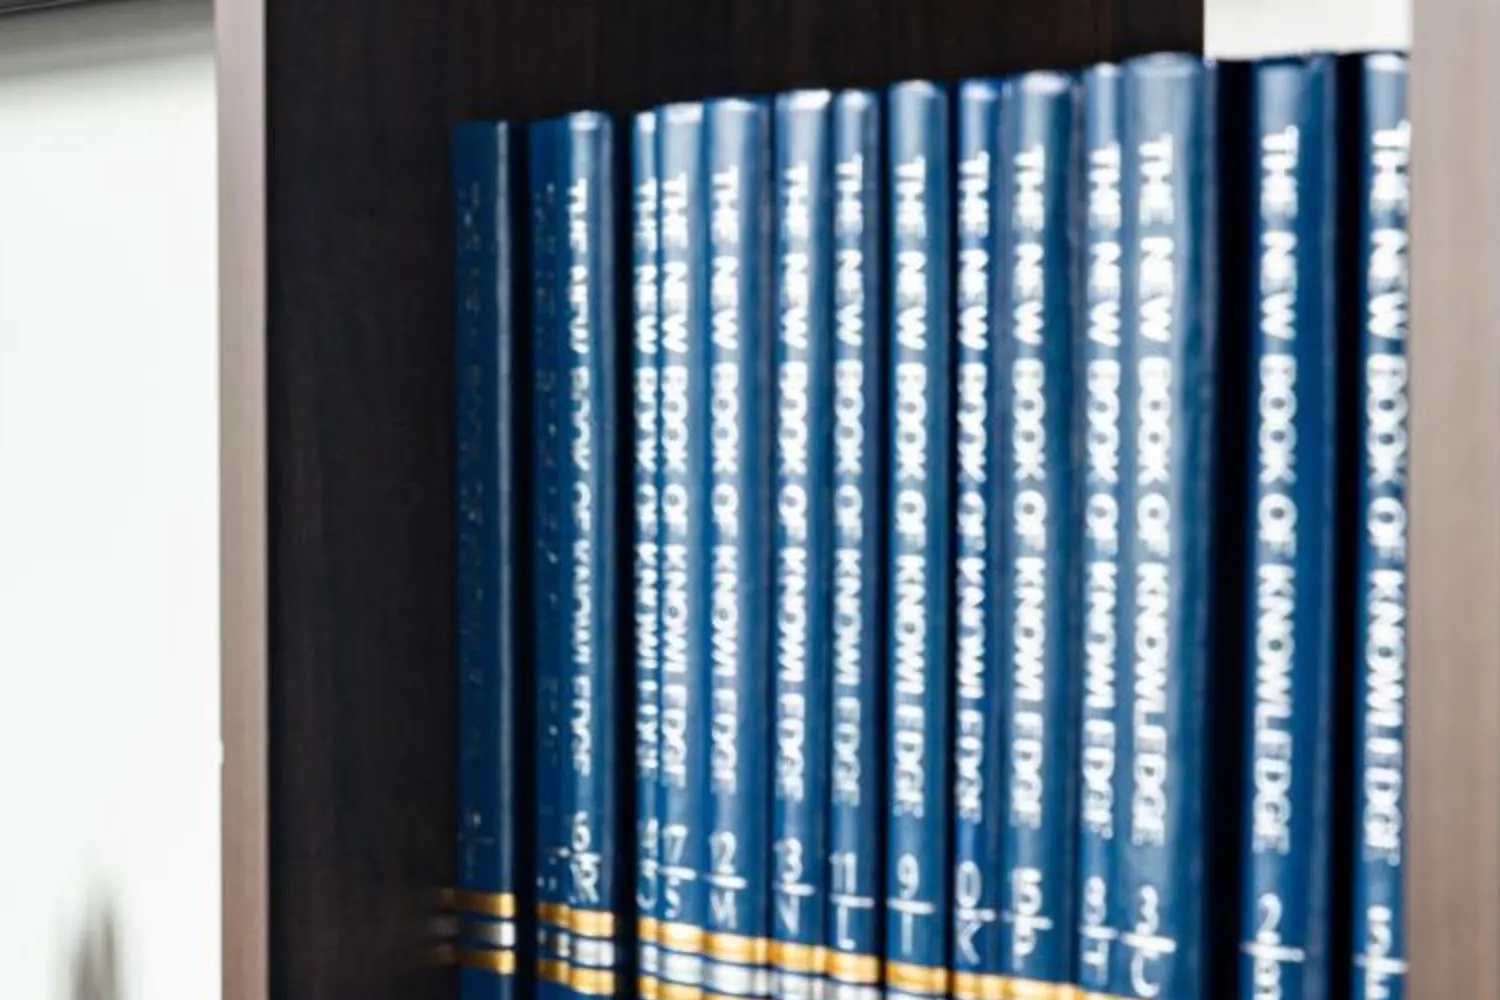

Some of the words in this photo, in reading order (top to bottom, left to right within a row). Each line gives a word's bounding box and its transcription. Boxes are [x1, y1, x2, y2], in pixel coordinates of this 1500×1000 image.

[662, 173, 690, 247] THE
[711, 167, 739, 243] THE
[782, 162, 809, 237] THE
[835, 155, 864, 232] THE
[896, 157, 927, 232] THE
[958, 152, 990, 232] THE
[1013, 145, 1045, 227] THE
[1088, 143, 1122, 226] THE
[1138, 137, 1174, 215] THE
[1261, 127, 1300, 212] THE
[1370, 124, 1409, 212] THE
[661, 260, 690, 354] NEW
[710, 256, 739, 351] NEW
[779, 253, 810, 350] NEW
[834, 248, 864, 348] NEW
[896, 250, 927, 351] NEW
[958, 248, 989, 350] NEW
[1013, 243, 1045, 345] NEW
[1087, 242, 1121, 348] NEW
[1138, 236, 1174, 343] NEW
[1259, 231, 1298, 340] NEW
[1367, 228, 1407, 340] NEW
[660, 365, 690, 470] BOOK
[710, 363, 739, 473] BOOK
[778, 361, 809, 473] BOOK
[834, 360, 863, 474] BOOK
[895, 363, 927, 479] BOOK
[957, 362, 988, 478] BOOK
[1012, 359, 1045, 478] BOOK
[1086, 358, 1120, 482] BOOK
[1137, 357, 1172, 483] BOOK
[1257, 354, 1297, 483] BOOK
[1366, 354, 1406, 480] BOOK
[660, 483, 689, 538] OF
[710, 484, 739, 539] OF
[778, 485, 809, 542] OF
[833, 485, 863, 544] OF
[894, 490, 926, 551] OF
[957, 491, 987, 552] OF
[1012, 490, 1045, 553] OF
[1085, 492, 1119, 555] OF
[1136, 493, 1171, 558] OF
[1258, 493, 1297, 560] OF
[1366, 497, 1405, 562] OF
[660, 544, 688, 790] KNOWLEDGE
[710, 545, 739, 795] KNOWLEDGE
[776, 547, 808, 802] KNOWLEDGE
[832, 548, 862, 808] KNOWLEDGE
[893, 554, 926, 819] KNOWLEDGE
[956, 558, 986, 823] KNOWLEDGE
[1012, 556, 1045, 828] KNOWLEDGE
[1082, 561, 1117, 840] KNOWLEDGE
[1132, 563, 1171, 846] KNOWLEDGE
[1253, 564, 1295, 852] KNOWLEDGE
[1363, 570, 1403, 863] KNOWLEDGE
[664, 877, 682, 919] S
[896, 853, 919, 899] 9
[1138, 884, 1160, 937] 3
[1256, 892, 1282, 944] 2
[836, 905, 856, 950] L
[1012, 922, 1038, 971] P
[1131, 948, 1160, 999] C
[1365, 904, 1393, 955] 5
